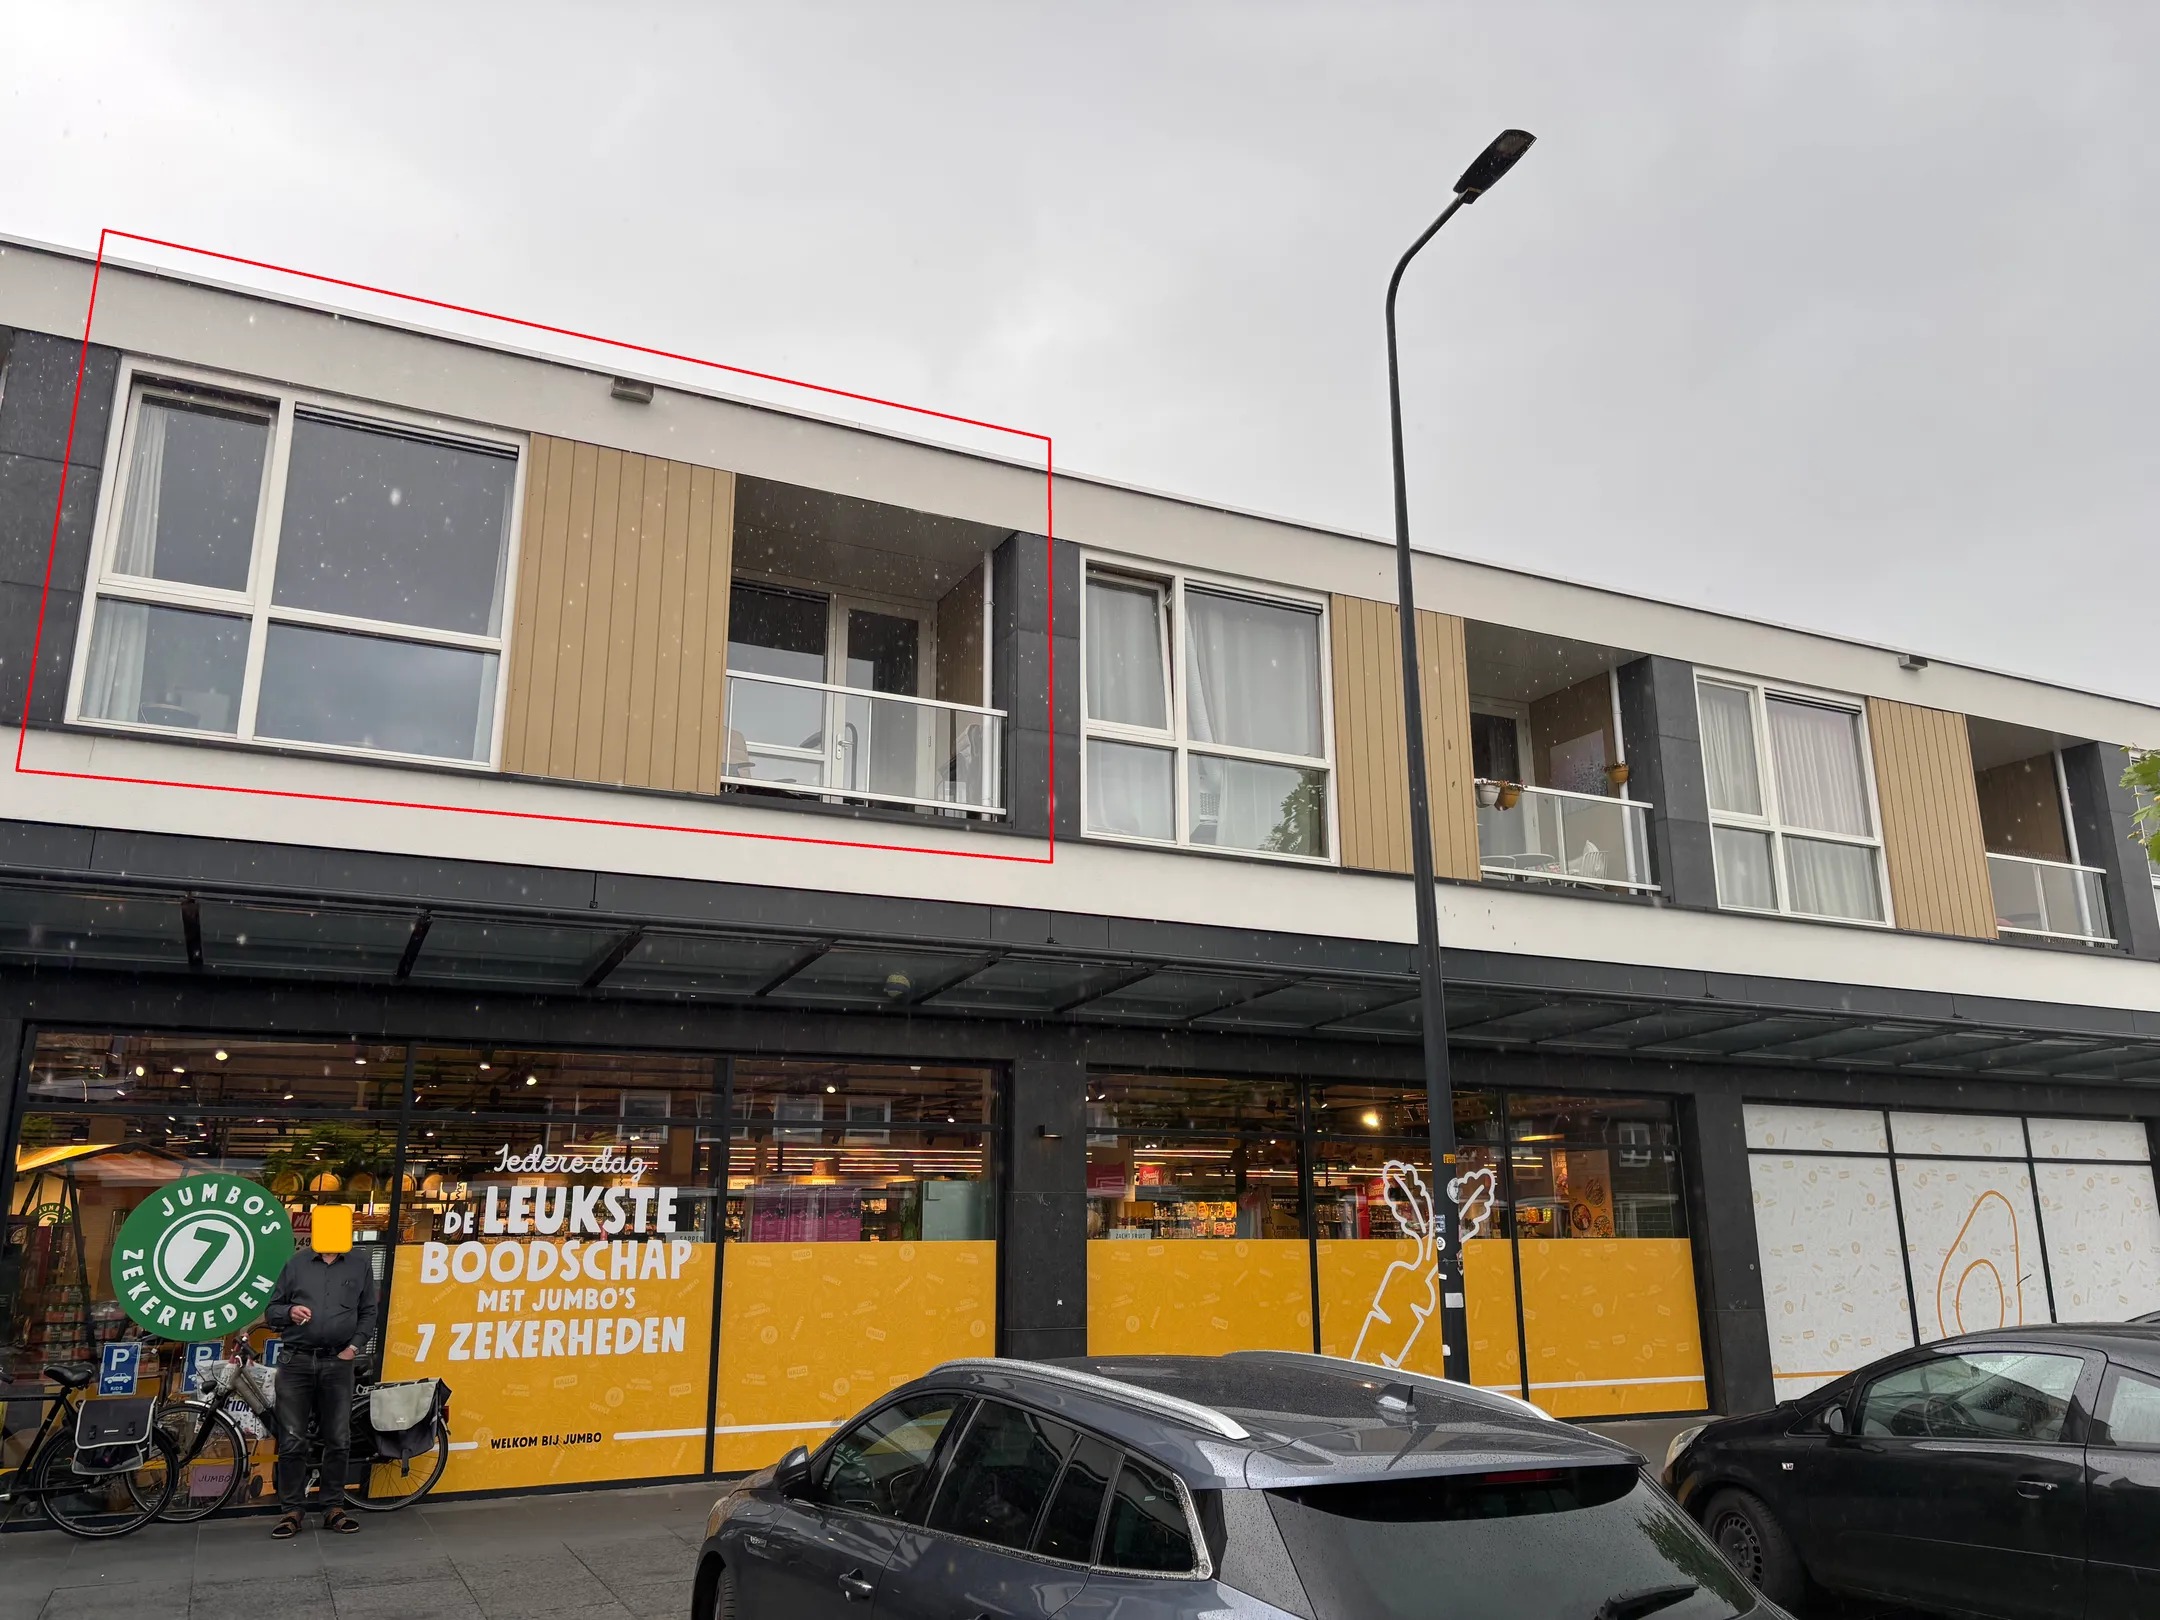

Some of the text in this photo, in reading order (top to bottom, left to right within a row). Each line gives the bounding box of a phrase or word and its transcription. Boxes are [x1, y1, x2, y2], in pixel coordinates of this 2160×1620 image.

[591, 1144, 649, 1182] dag
[161, 1183, 281, 1235] JUMBO'S
[443, 1185, 678, 1234] DE LEUKSTE
[183, 1226, 231, 1285] 7
[420, 1240, 692, 1284] BOODSCHAP
[122, 1249, 274, 1331] ZEKERHEDEN
[477, 1289, 525, 1313] MET
[532, 1287, 636, 1312] JUMBO'S
[111, 1348, 130, 1370] P
[414, 1316, 685, 1362] 7 ZEKERHEDEN
[490, 1432, 602, 1449] WELKOM BIJ JUMBO
